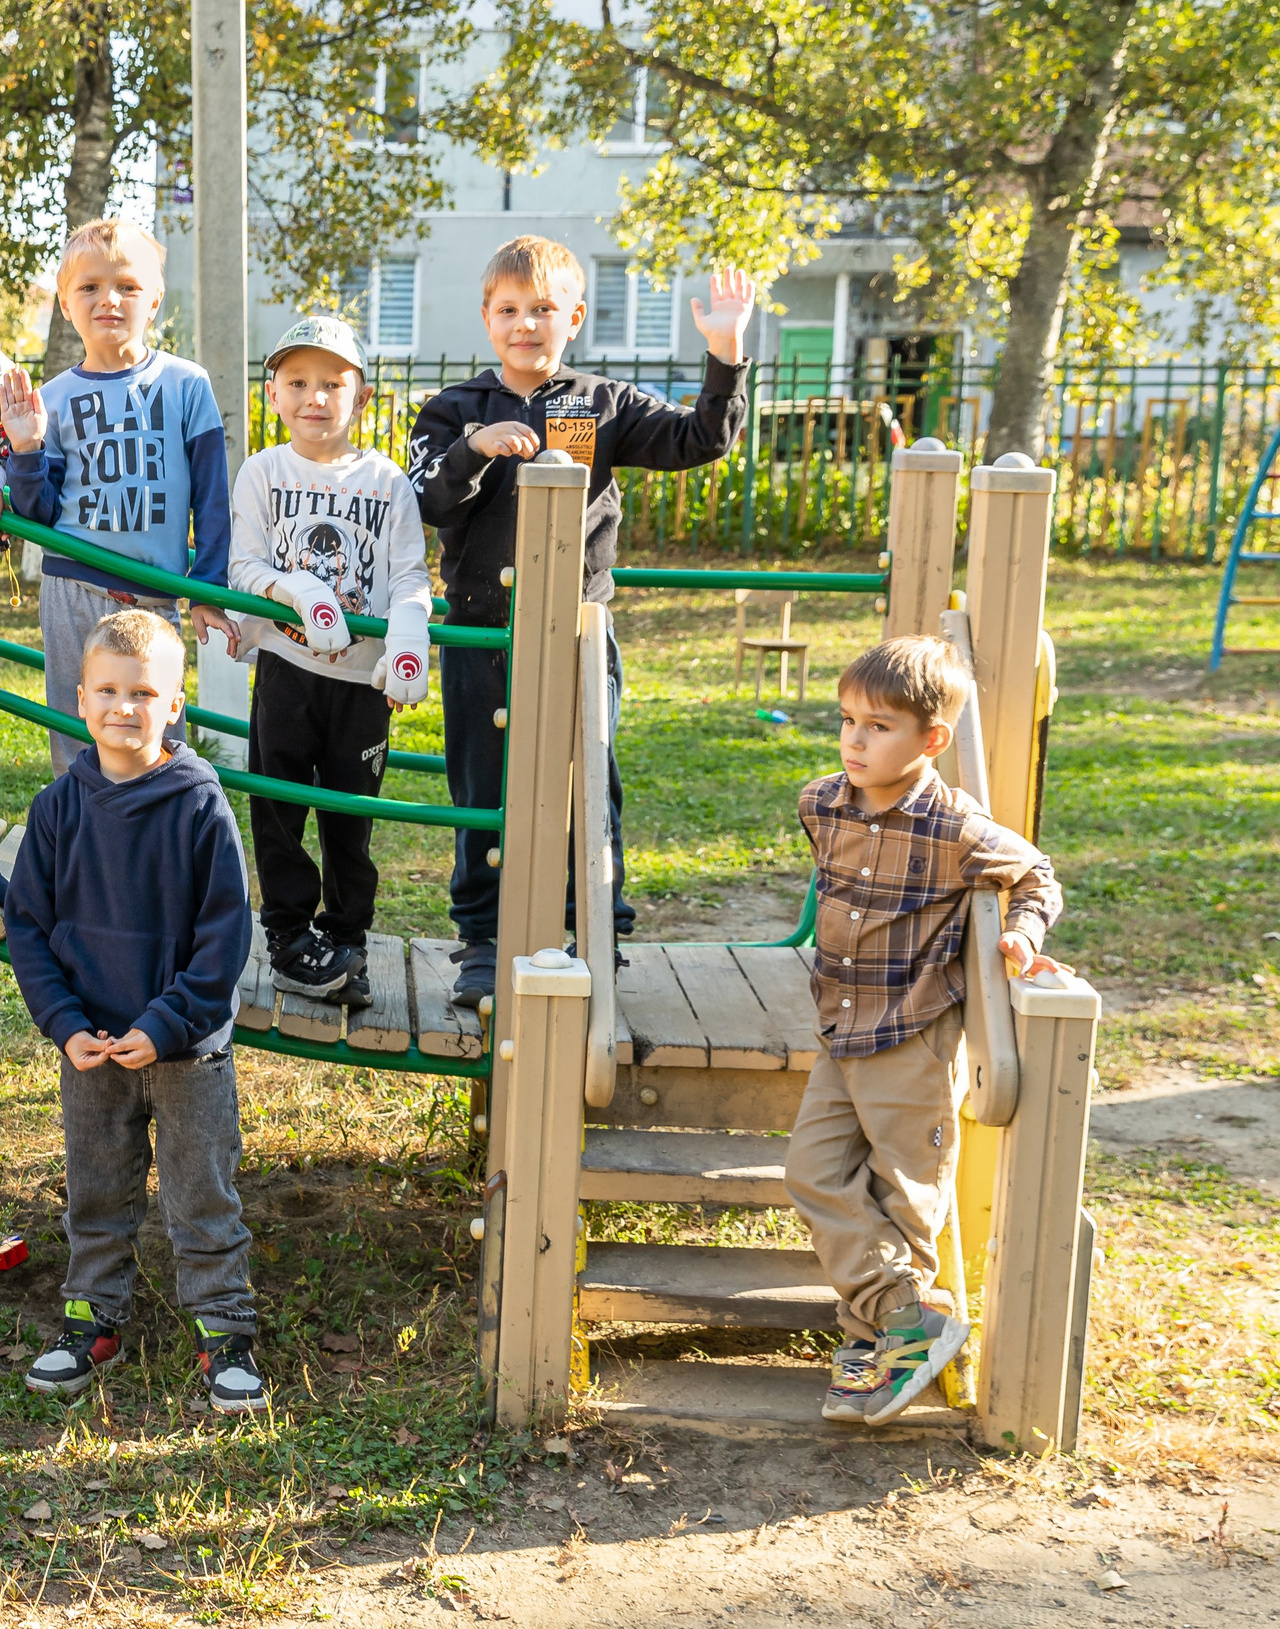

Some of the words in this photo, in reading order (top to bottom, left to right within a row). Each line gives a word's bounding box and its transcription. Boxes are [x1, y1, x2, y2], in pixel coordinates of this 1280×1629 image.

[70, 384, 165, 441] PLAY
[545, 395, 592, 406] FUTURE
[548, 421, 594, 433] NO-159
[78, 436, 166, 487] YOUR
[271, 481, 391, 499] EGENDARY
[78, 486, 166, 533] GAME
